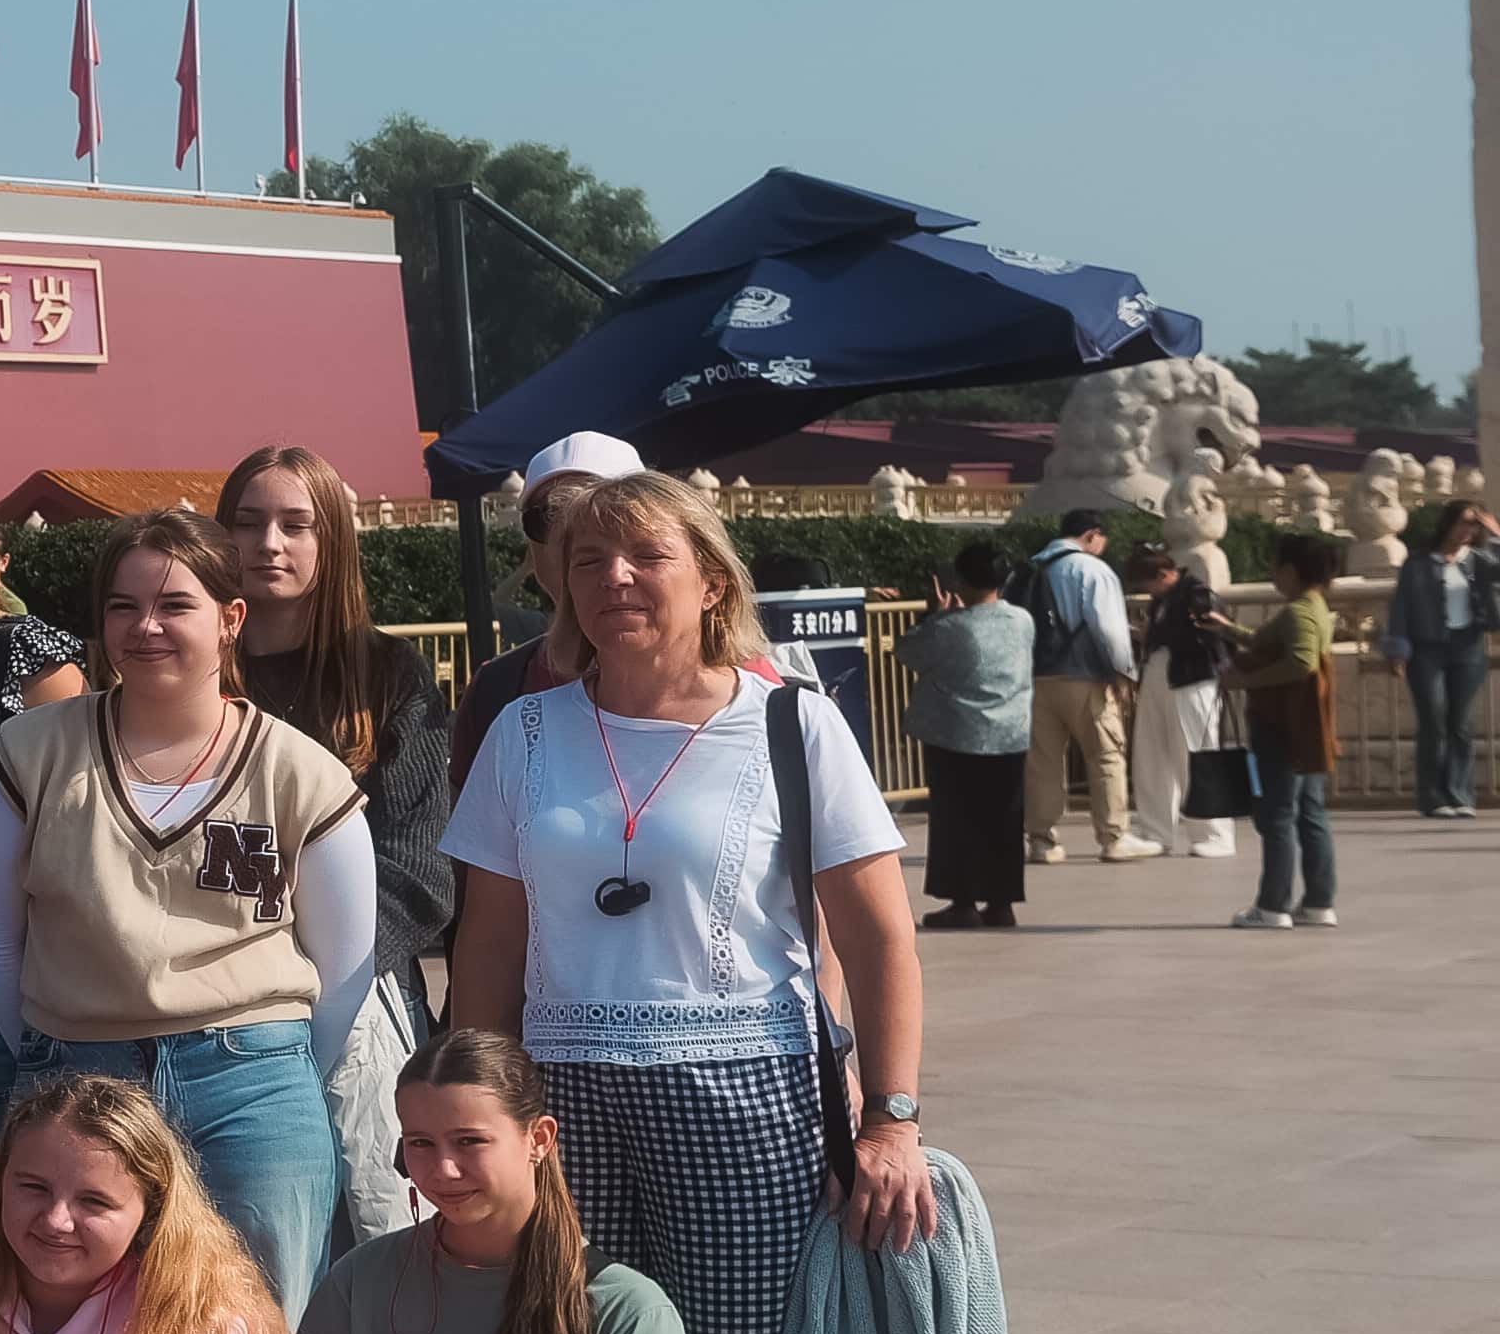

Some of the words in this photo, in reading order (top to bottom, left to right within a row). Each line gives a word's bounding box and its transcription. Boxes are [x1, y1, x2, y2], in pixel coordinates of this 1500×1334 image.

[704, 361, 759, 385] POLICE
[792, 610, 857, 635] 天安门分局
[197, 819, 285, 922] NY
